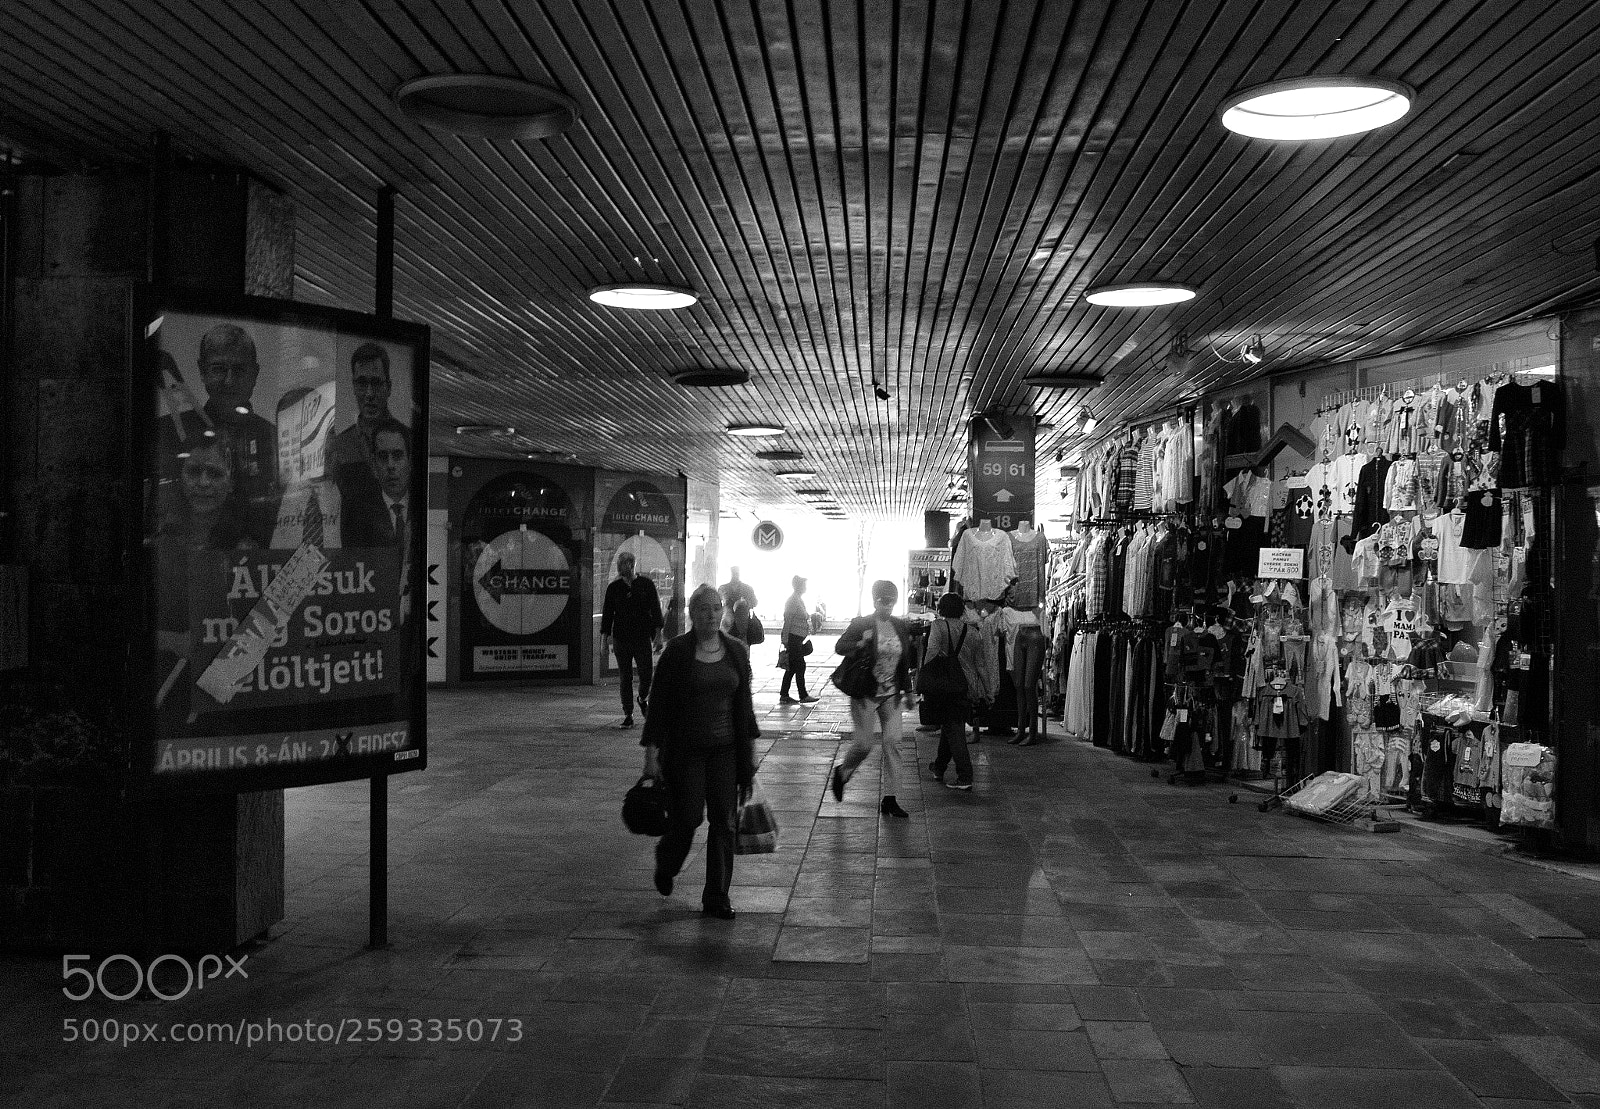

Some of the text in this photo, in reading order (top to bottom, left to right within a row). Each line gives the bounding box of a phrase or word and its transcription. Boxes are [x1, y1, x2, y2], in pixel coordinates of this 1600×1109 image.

[982, 462, 1025, 476] 59 61
[612, 513, 670, 523] interCHANGE
[995, 515, 1011, 528] 18
[227, 556, 376, 599] Álsuk
[489, 575, 571, 589] CHANGE
[303, 605, 391, 637] Soros
[1396, 609, 1402, 621] I
